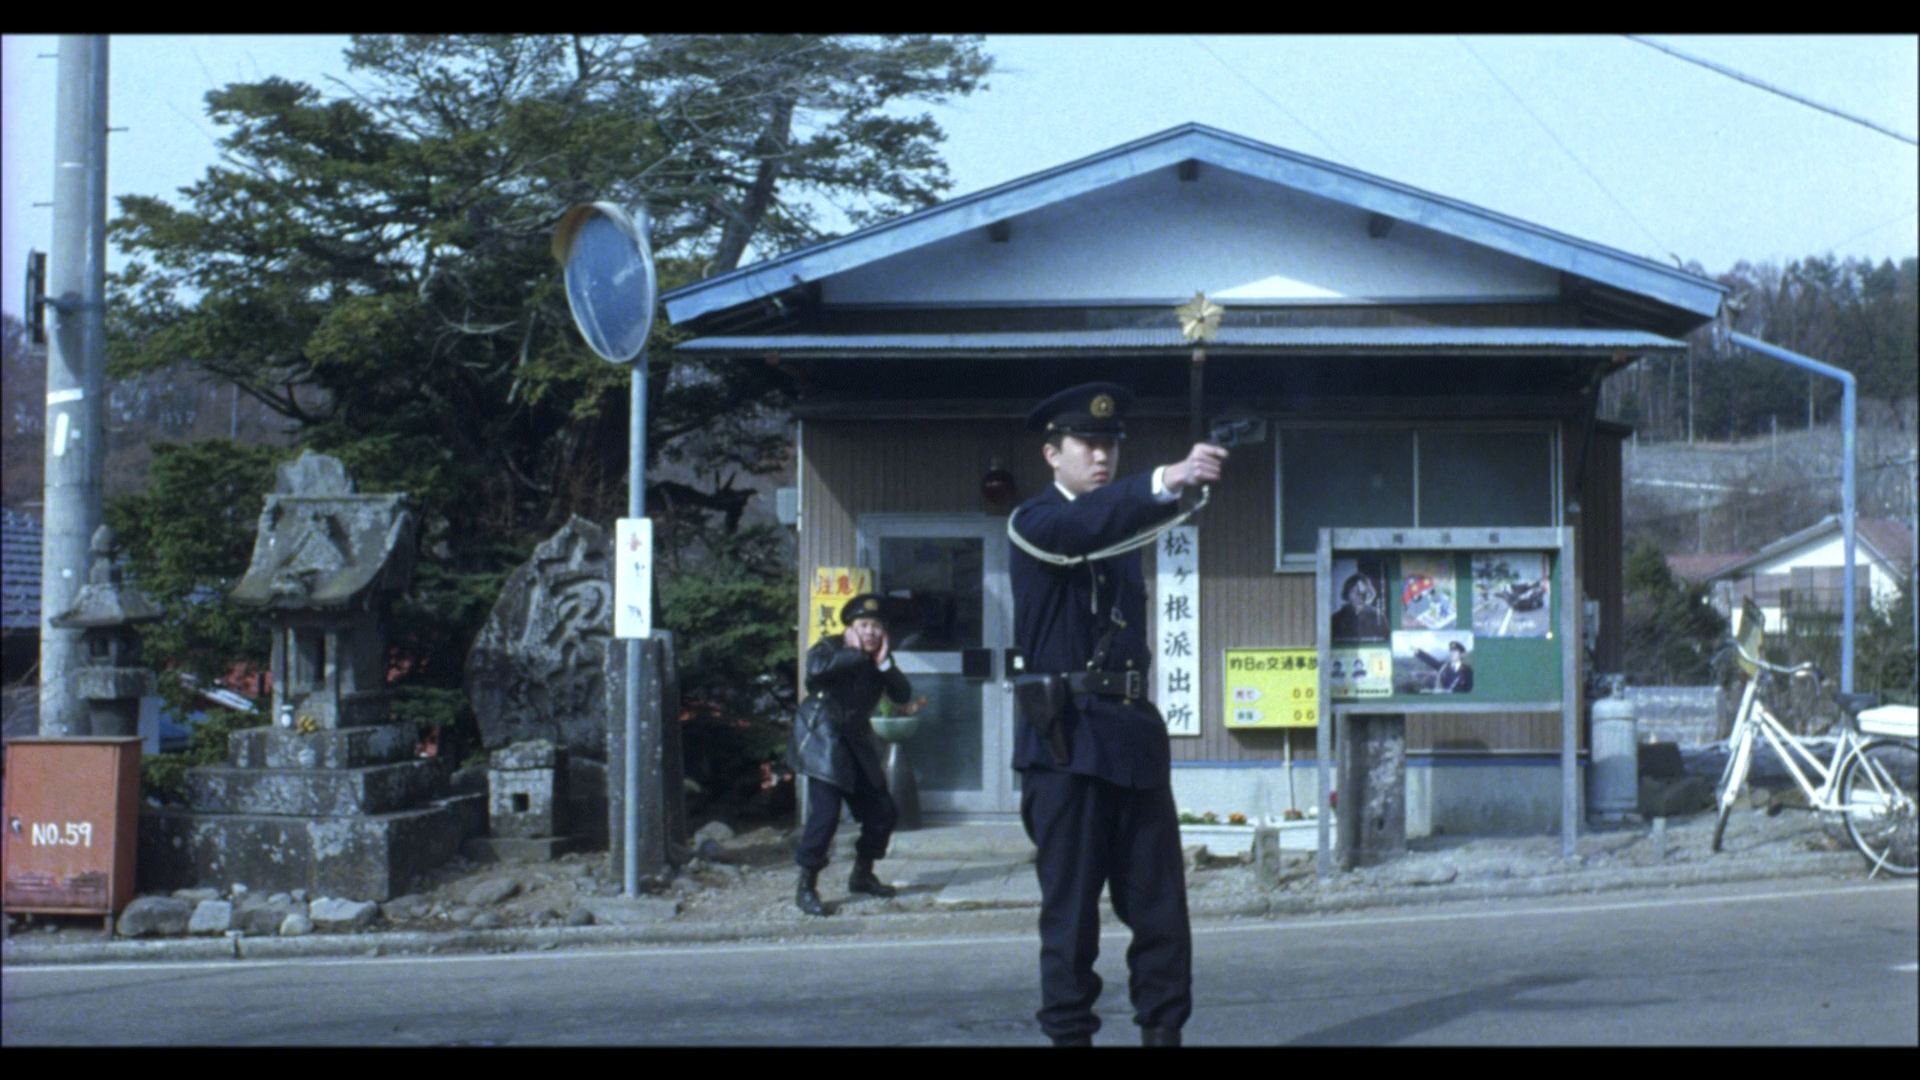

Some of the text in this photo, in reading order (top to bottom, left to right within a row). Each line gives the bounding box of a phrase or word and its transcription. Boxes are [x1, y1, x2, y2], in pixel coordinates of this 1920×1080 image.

[1229, 655, 1318, 671] 昨日の交通事故
[31, 821, 93, 847] NO.59
